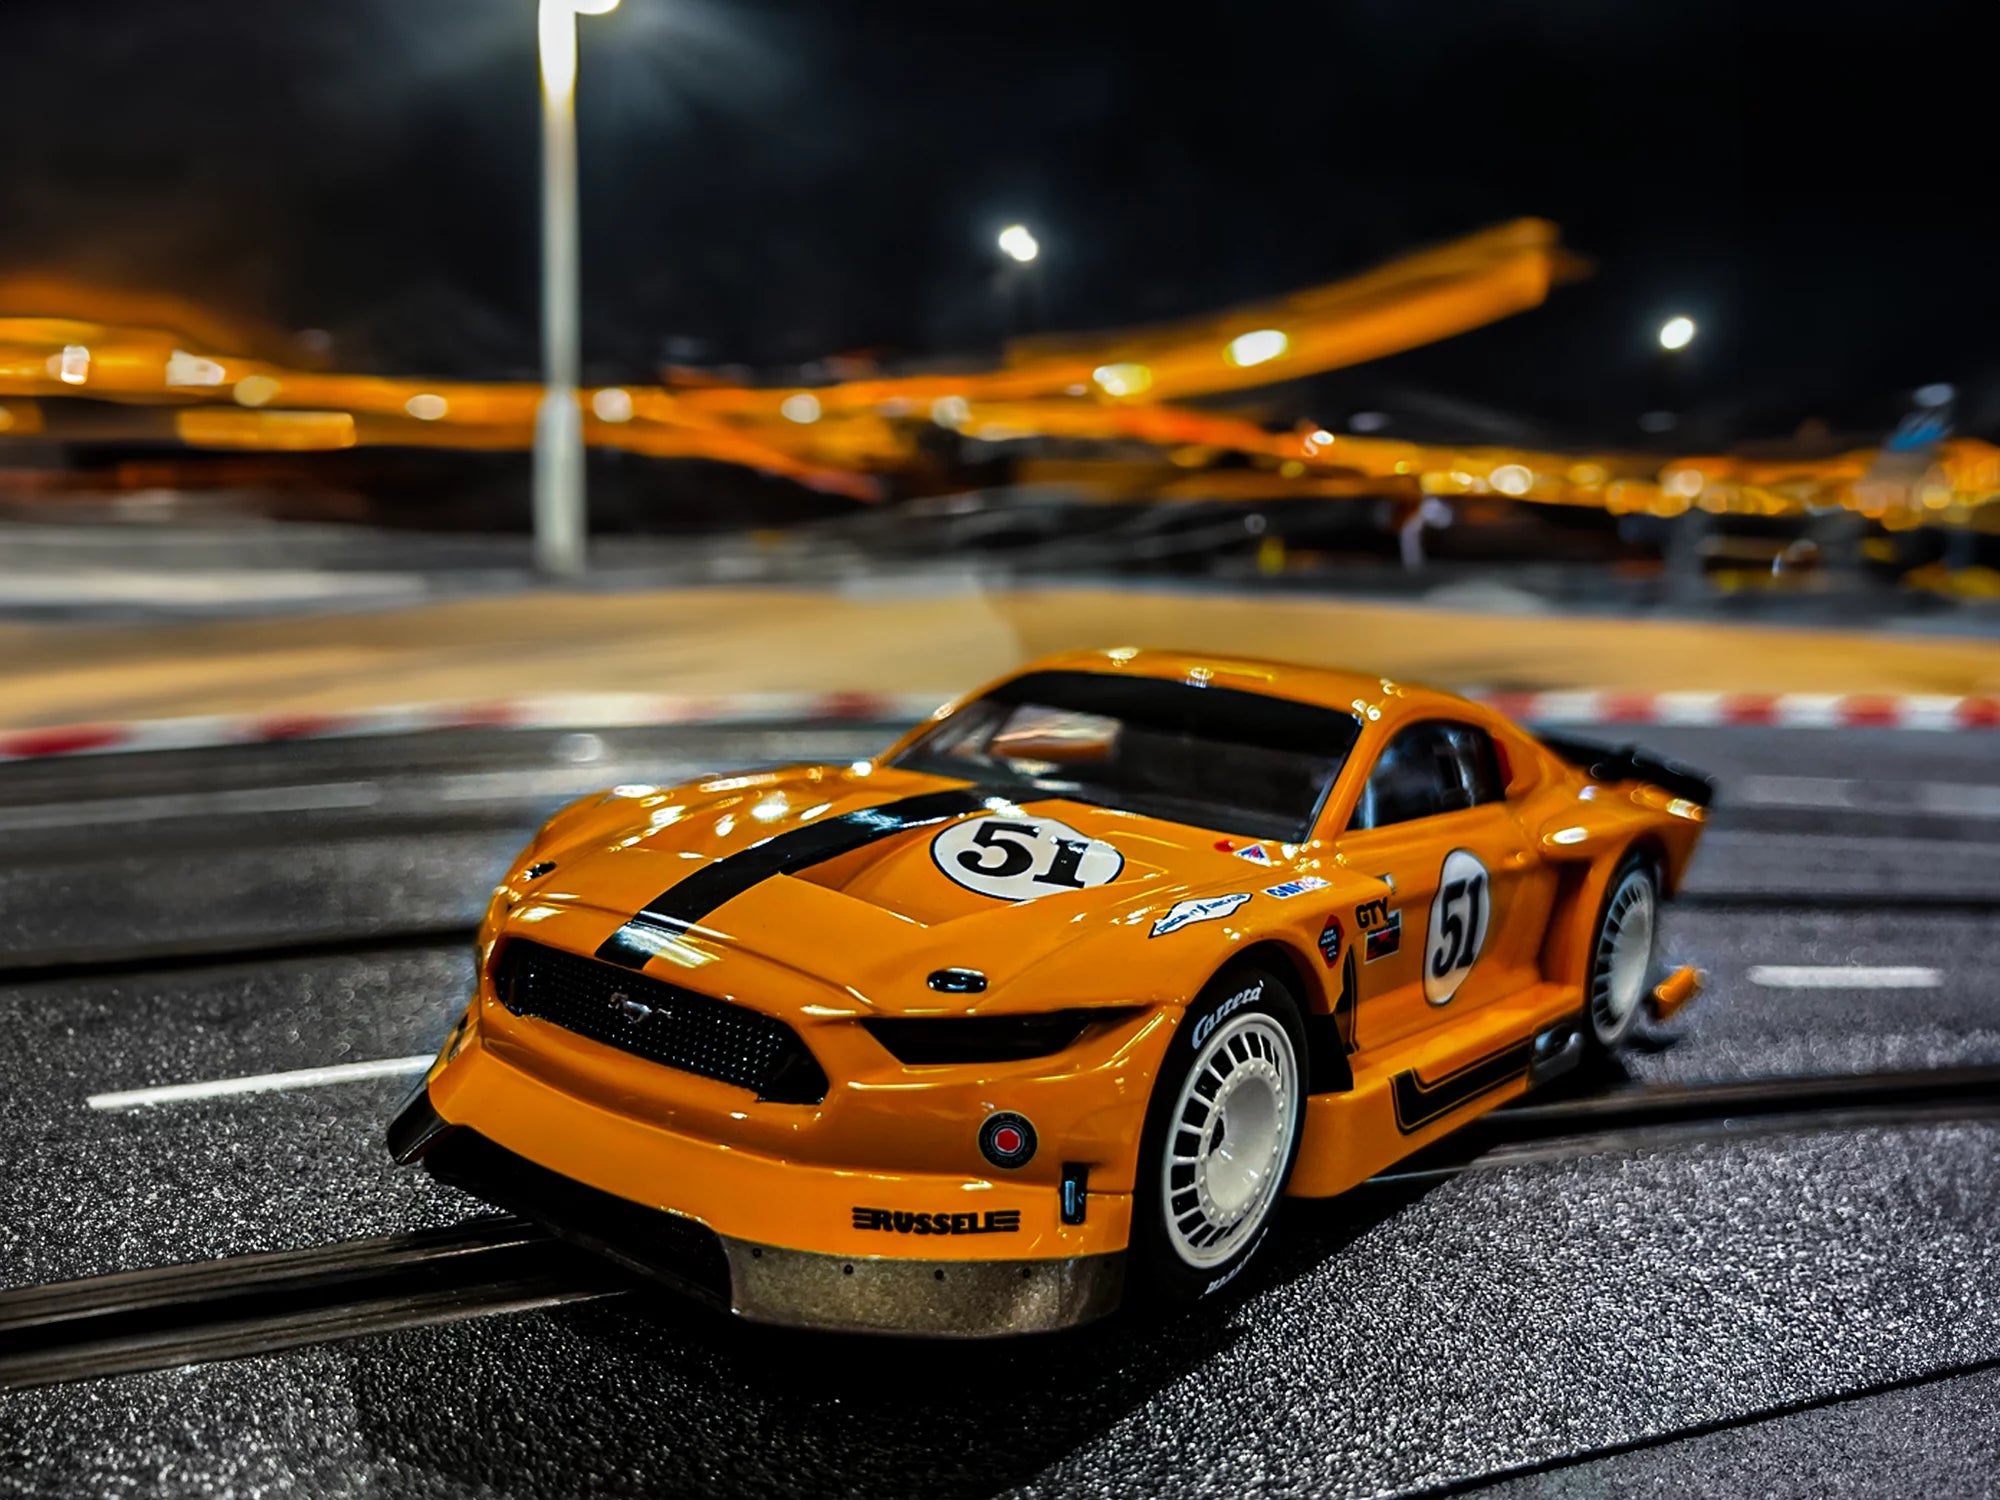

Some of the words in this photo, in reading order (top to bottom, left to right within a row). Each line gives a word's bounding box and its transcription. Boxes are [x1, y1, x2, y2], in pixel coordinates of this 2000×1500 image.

[957, 820, 1089, 889] 51
[1355, 896, 1388, 928] GTY
[1432, 874, 1483, 979] 51
[1192, 980, 1264, 1050] Carrera
